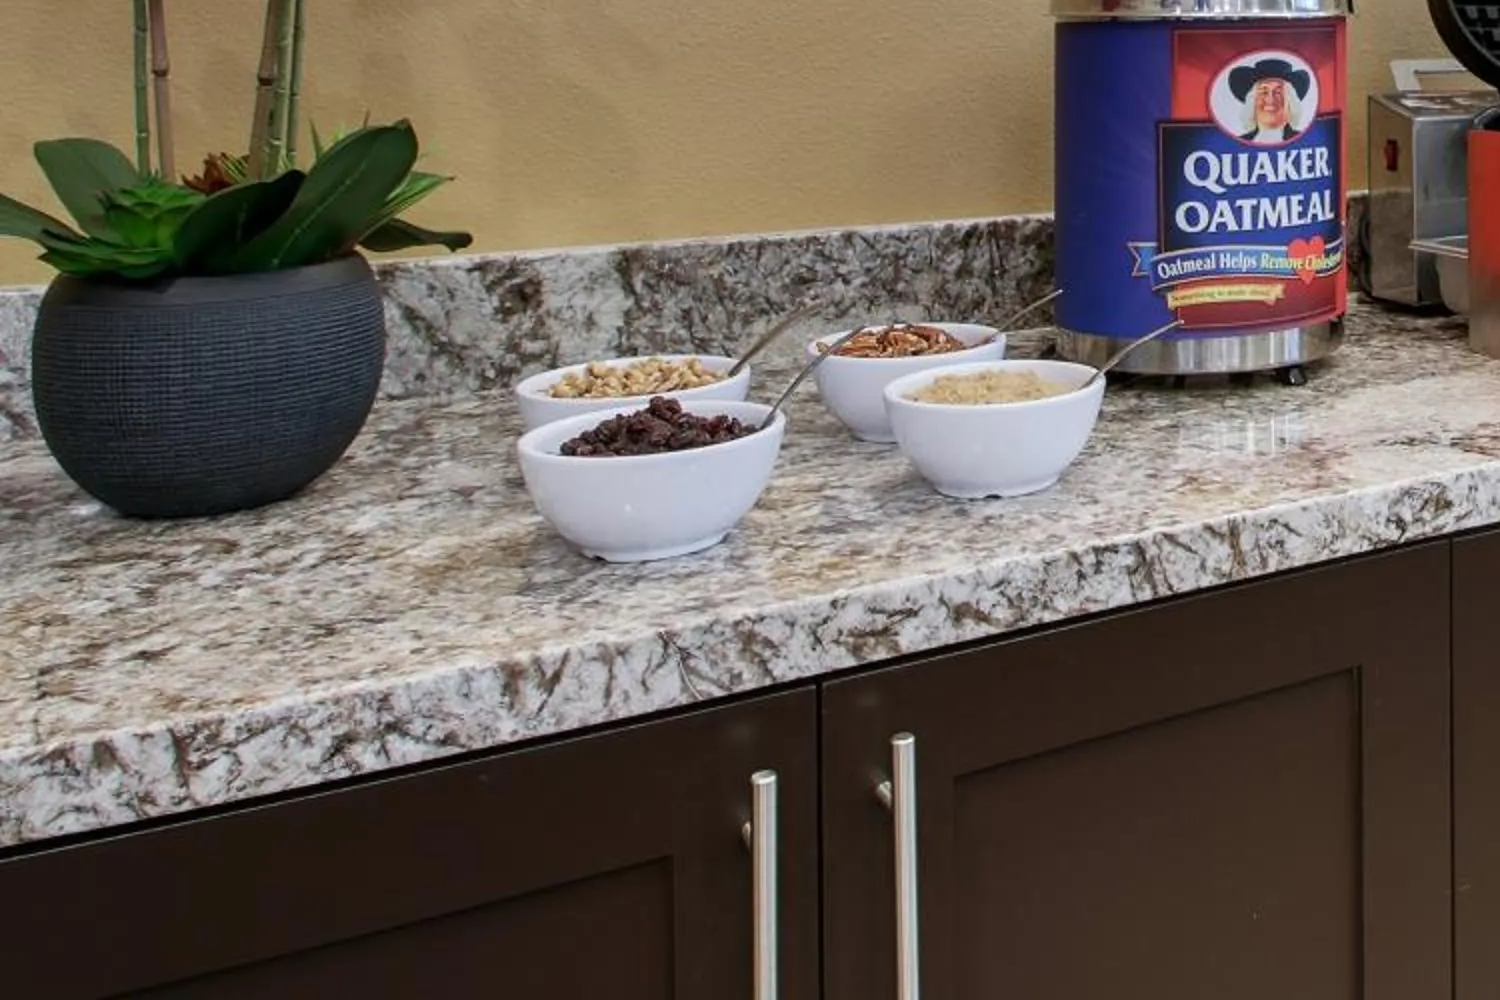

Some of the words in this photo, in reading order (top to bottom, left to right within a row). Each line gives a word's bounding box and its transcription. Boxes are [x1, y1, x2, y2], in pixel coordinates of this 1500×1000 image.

[1183, 147, 1329, 194] QUAKER
[1175, 189, 1335, 233] OATMEAL
[1157, 253, 1216, 279] Oatmeal
[1219, 253, 1258, 272] Helps
[1260, 252, 1304, 270] Remove
